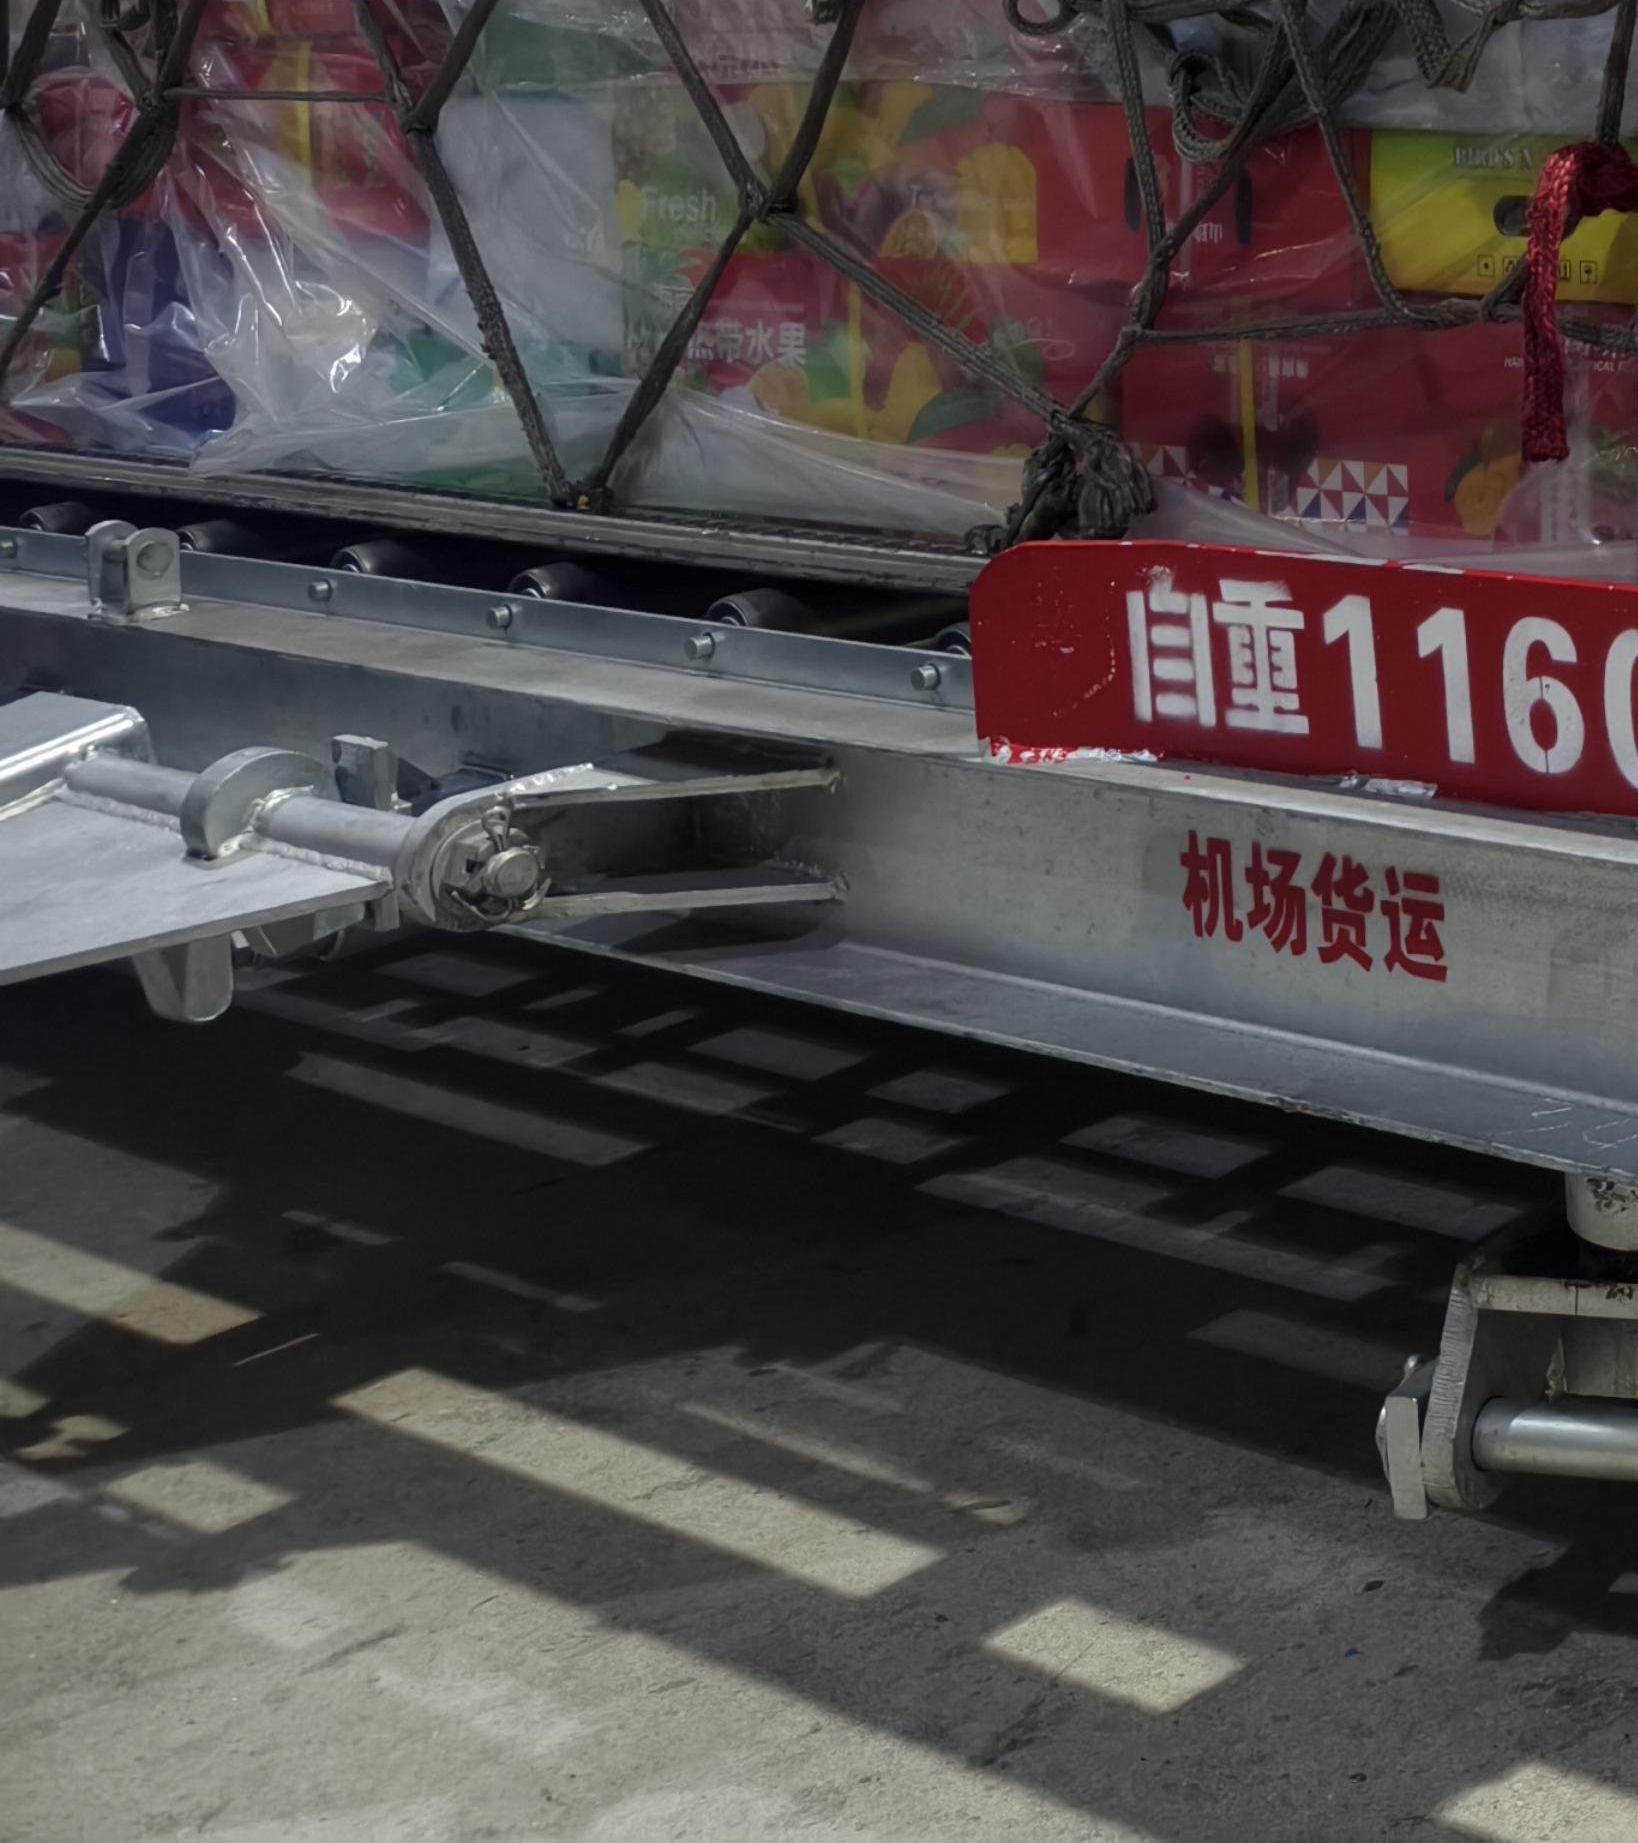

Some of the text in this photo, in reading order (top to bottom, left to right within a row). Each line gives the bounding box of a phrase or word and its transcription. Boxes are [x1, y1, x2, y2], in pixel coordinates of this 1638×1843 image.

[640, 186, 716, 223] Fresh
[1181, 830, 1448, 983] 机场货运
